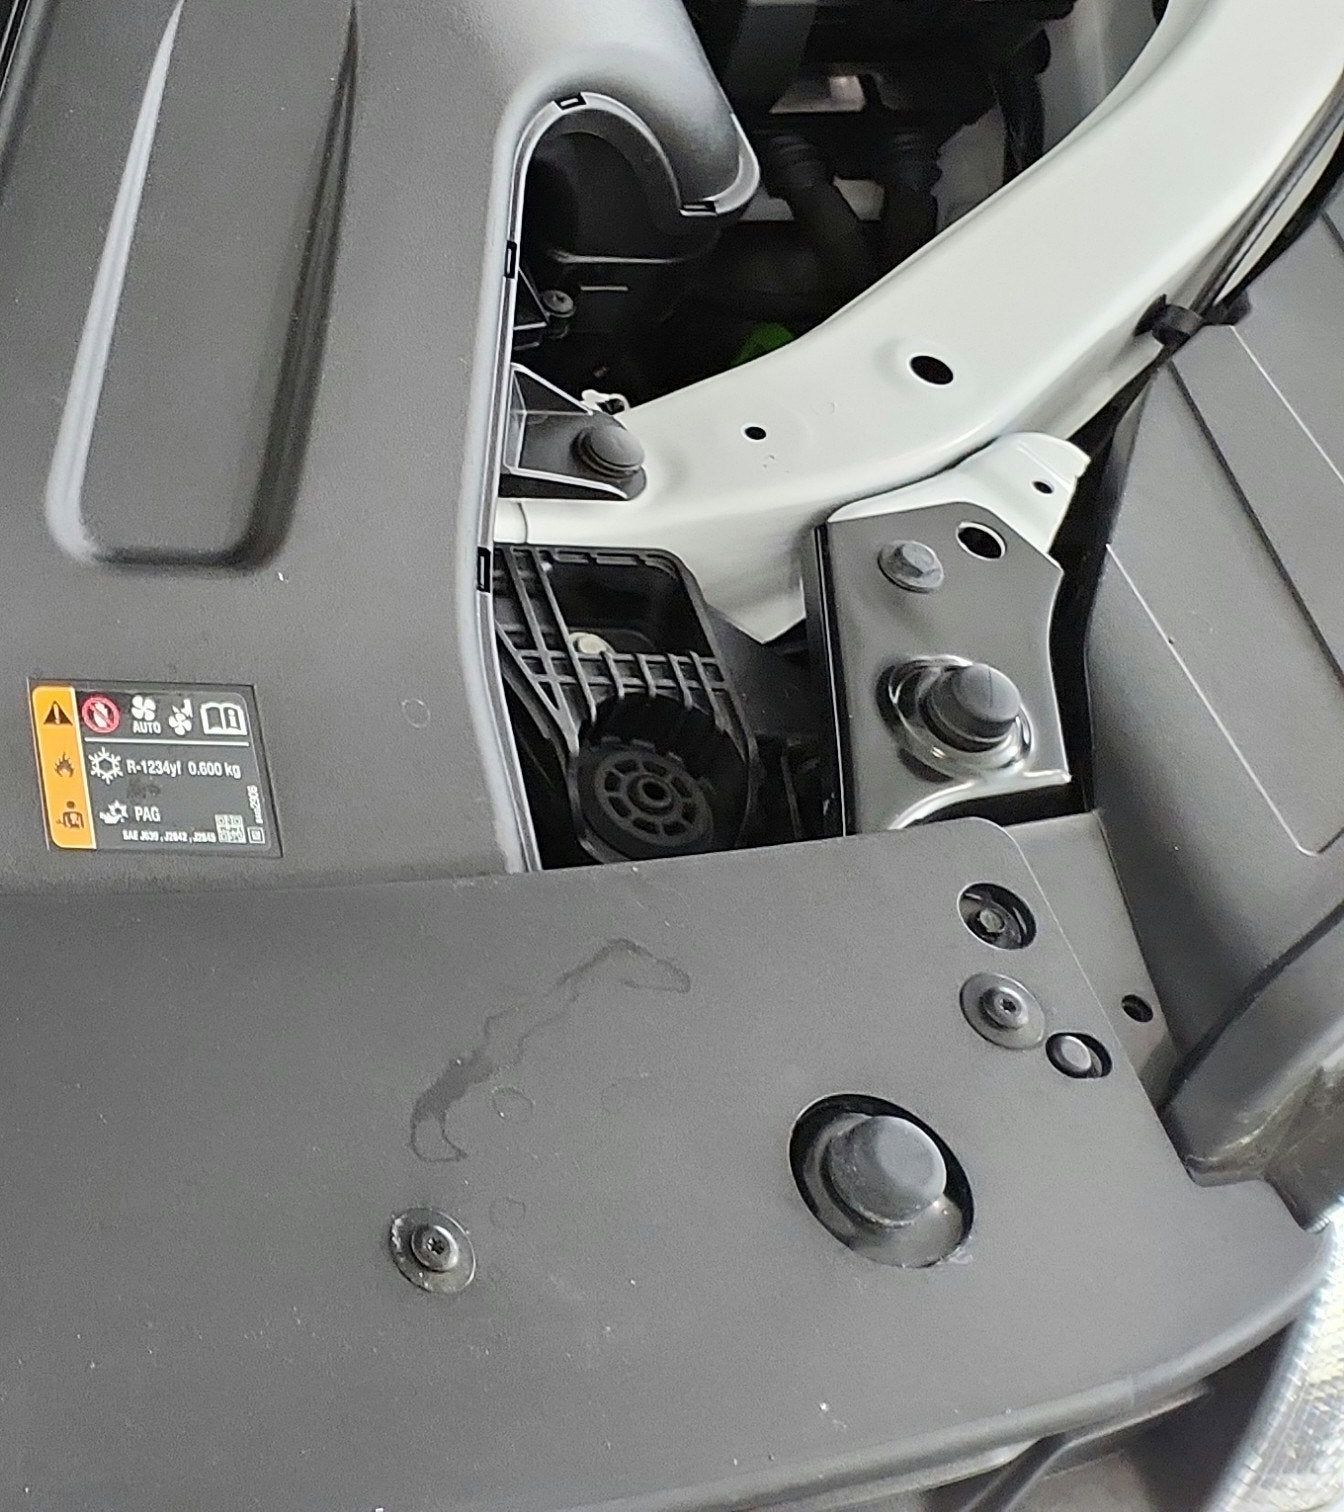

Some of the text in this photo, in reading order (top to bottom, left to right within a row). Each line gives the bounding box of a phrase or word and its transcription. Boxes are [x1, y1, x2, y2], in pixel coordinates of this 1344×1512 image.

[133, 720, 161, 734] AUTO
[188, 760, 223, 776] 0.600
[224, 762, 241, 779] kg
[134, 806, 161, 822] PAG
